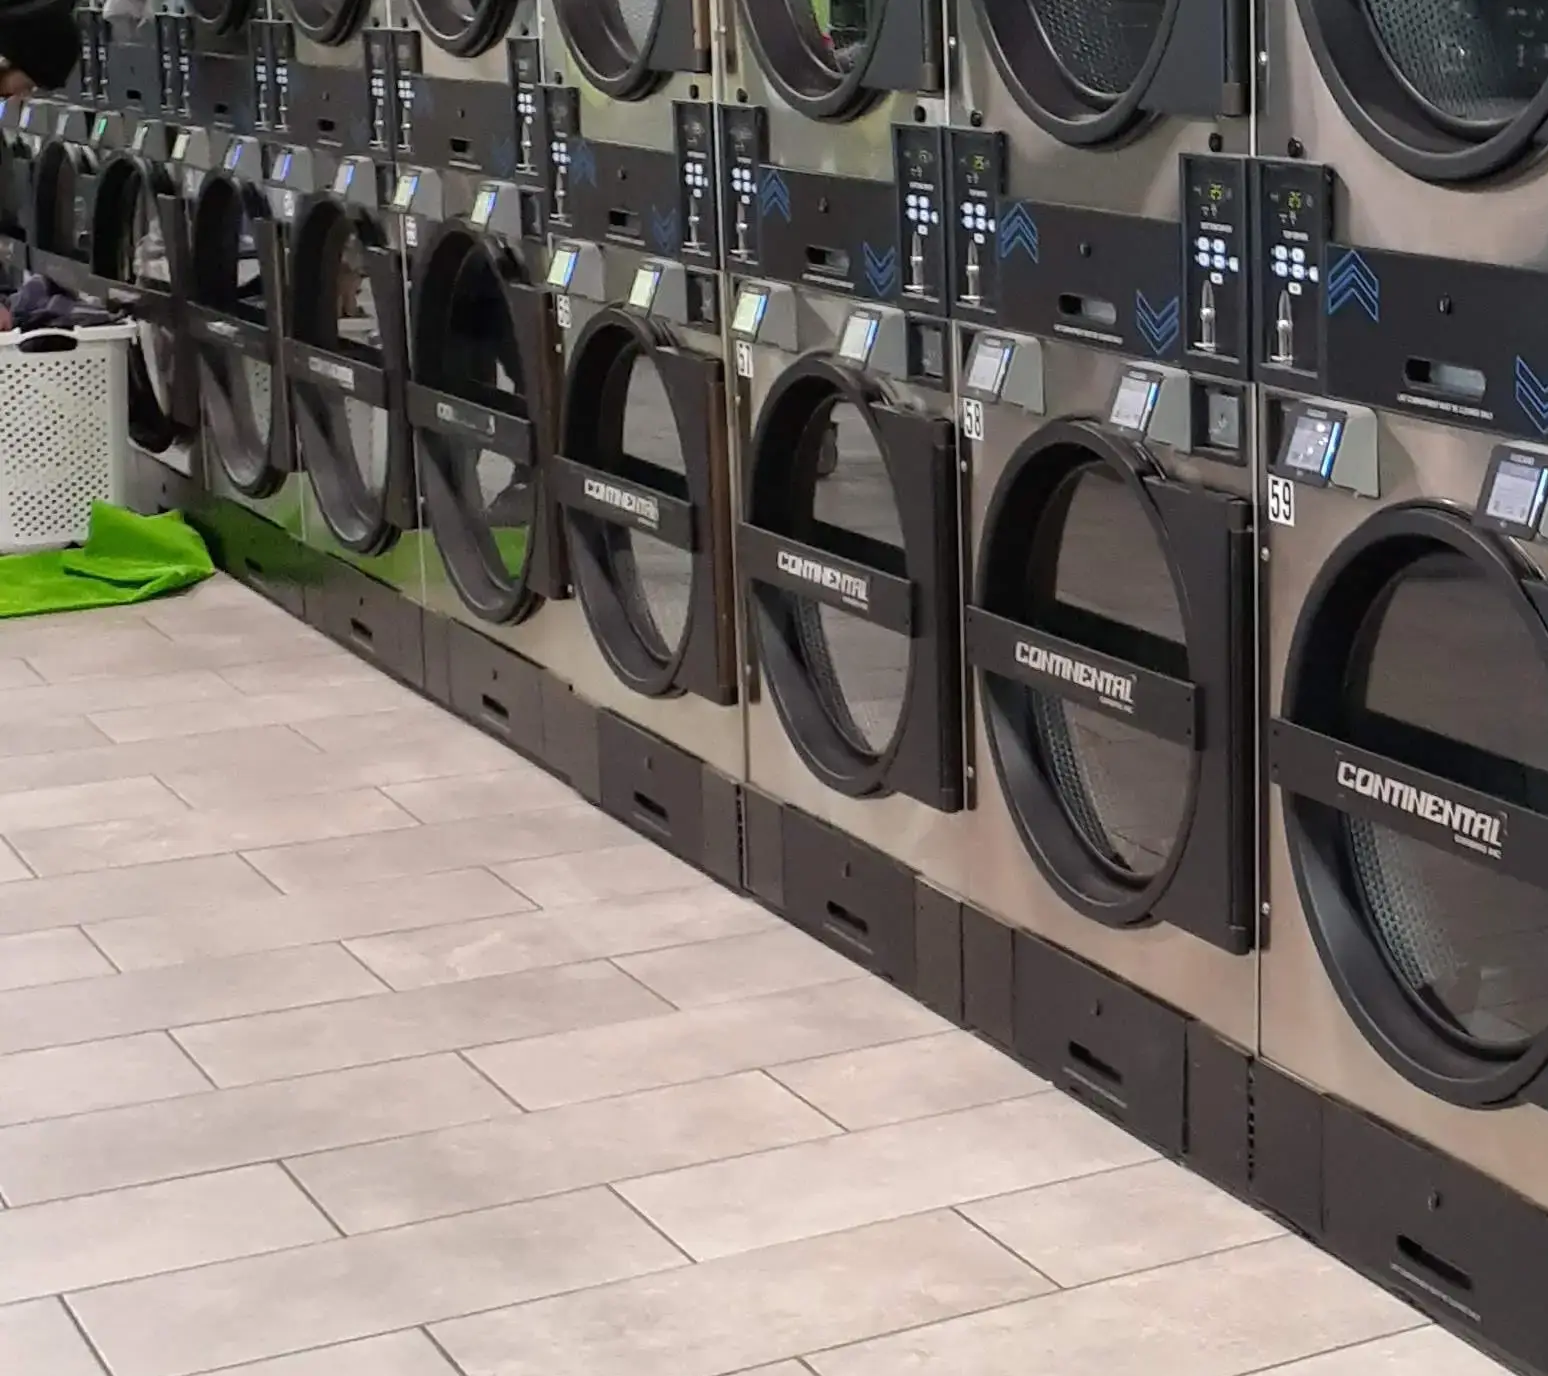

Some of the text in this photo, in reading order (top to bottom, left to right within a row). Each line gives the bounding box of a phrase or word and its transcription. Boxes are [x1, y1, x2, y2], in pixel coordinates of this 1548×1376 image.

[965, 401, 982, 438] 58
[1270, 479, 1292, 521] 59
[777, 550, 868, 602] CONTINENTAL
[1014, 640, 1135, 703] CONTINENTAL
[1336, 760, 1502, 847] CONTINENTAL
